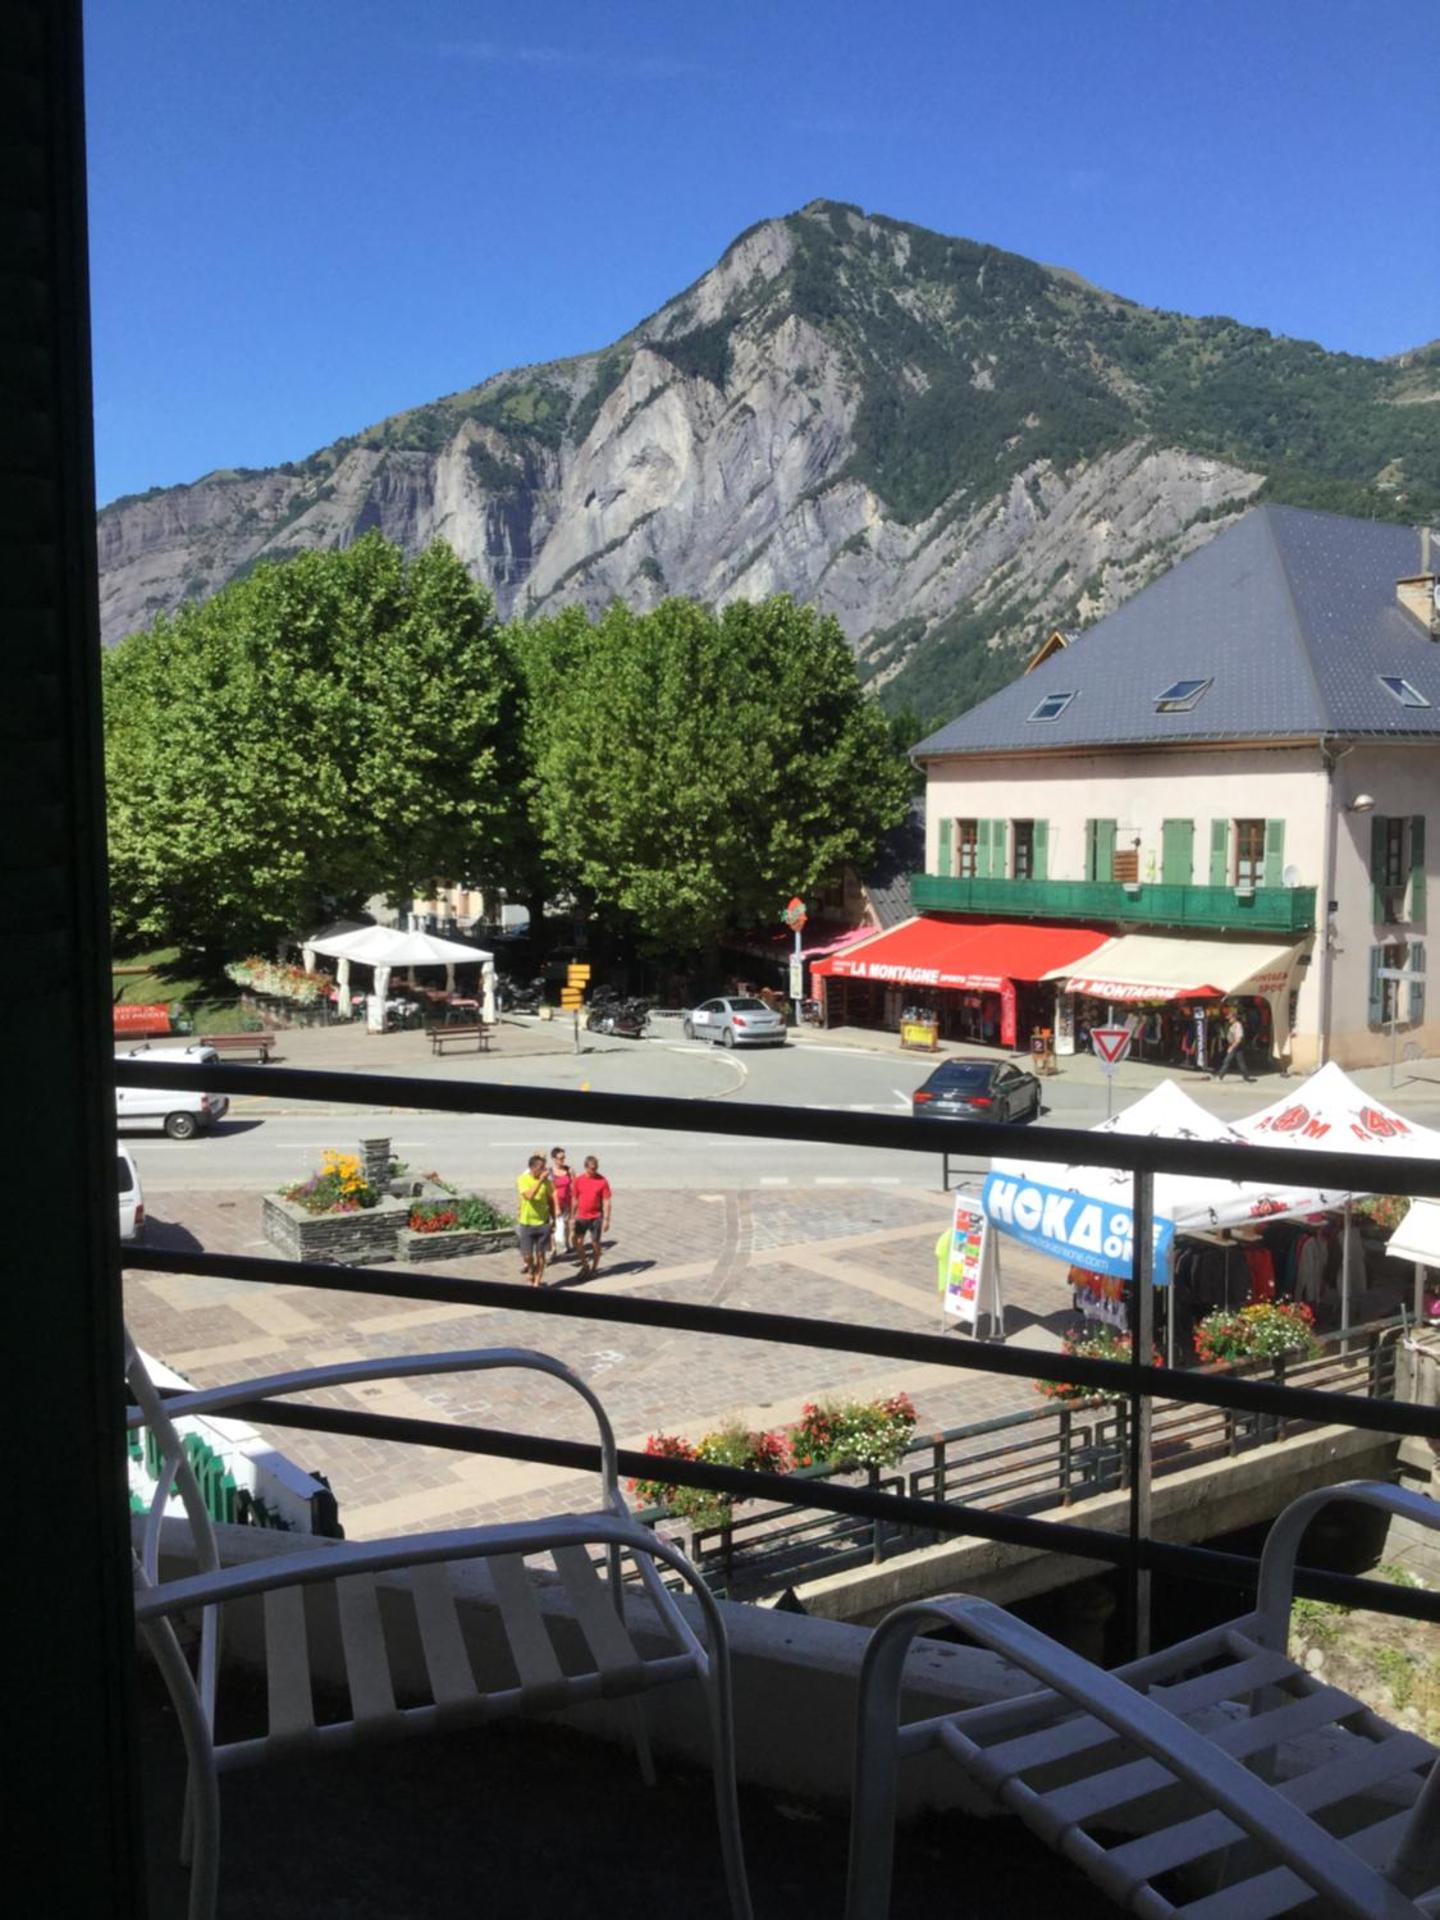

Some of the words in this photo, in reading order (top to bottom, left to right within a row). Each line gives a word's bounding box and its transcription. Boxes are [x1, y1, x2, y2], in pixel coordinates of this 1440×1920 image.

[850, 960, 866, 977] LA
[869, 963, 941, 985] MONTAGNE
[1065, 978, 1085, 993] LA
[1088, 982, 1177, 999] MONTAGNE
[988, 1179, 1103, 1255] HOKA
